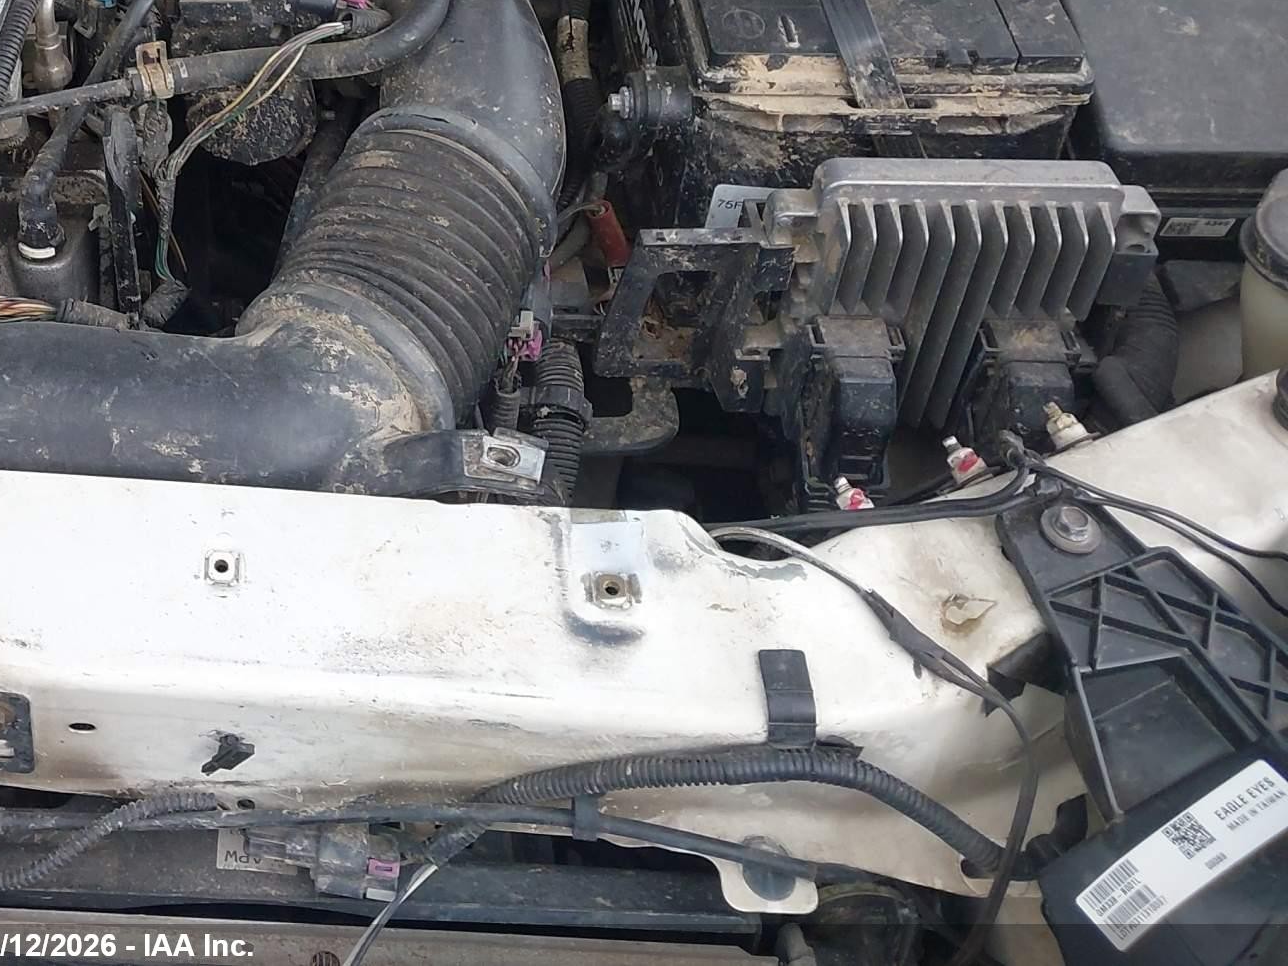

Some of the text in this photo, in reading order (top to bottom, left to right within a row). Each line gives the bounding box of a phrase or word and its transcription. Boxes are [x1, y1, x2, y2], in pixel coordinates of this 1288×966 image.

[1214, 776, 1275, 821] EAGLE EYES
[1226, 813, 1250, 832] MADE
[1256, 788, 1287, 811] TAIWAN
